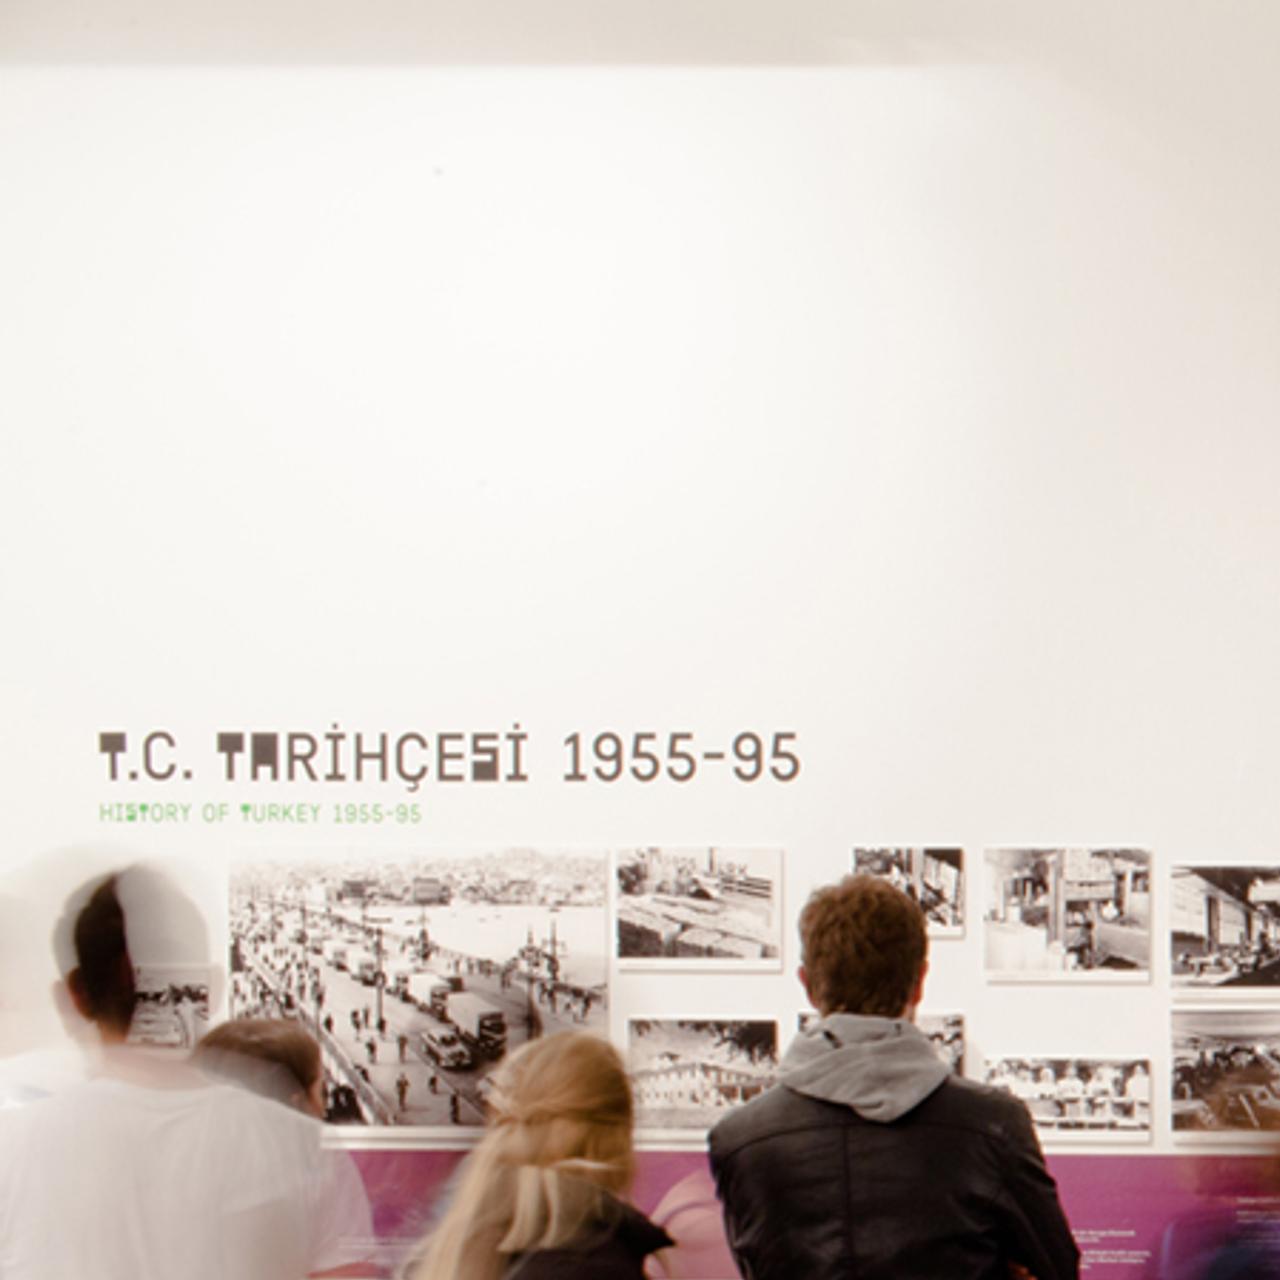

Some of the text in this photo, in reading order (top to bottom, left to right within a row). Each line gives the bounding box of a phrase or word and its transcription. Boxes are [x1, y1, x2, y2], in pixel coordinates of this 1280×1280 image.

[98, 722, 801, 793] T.C. TARİHÇESİ 1955-95
[99, 802, 422, 824] HISTORY OF TURKEY 1955-95
